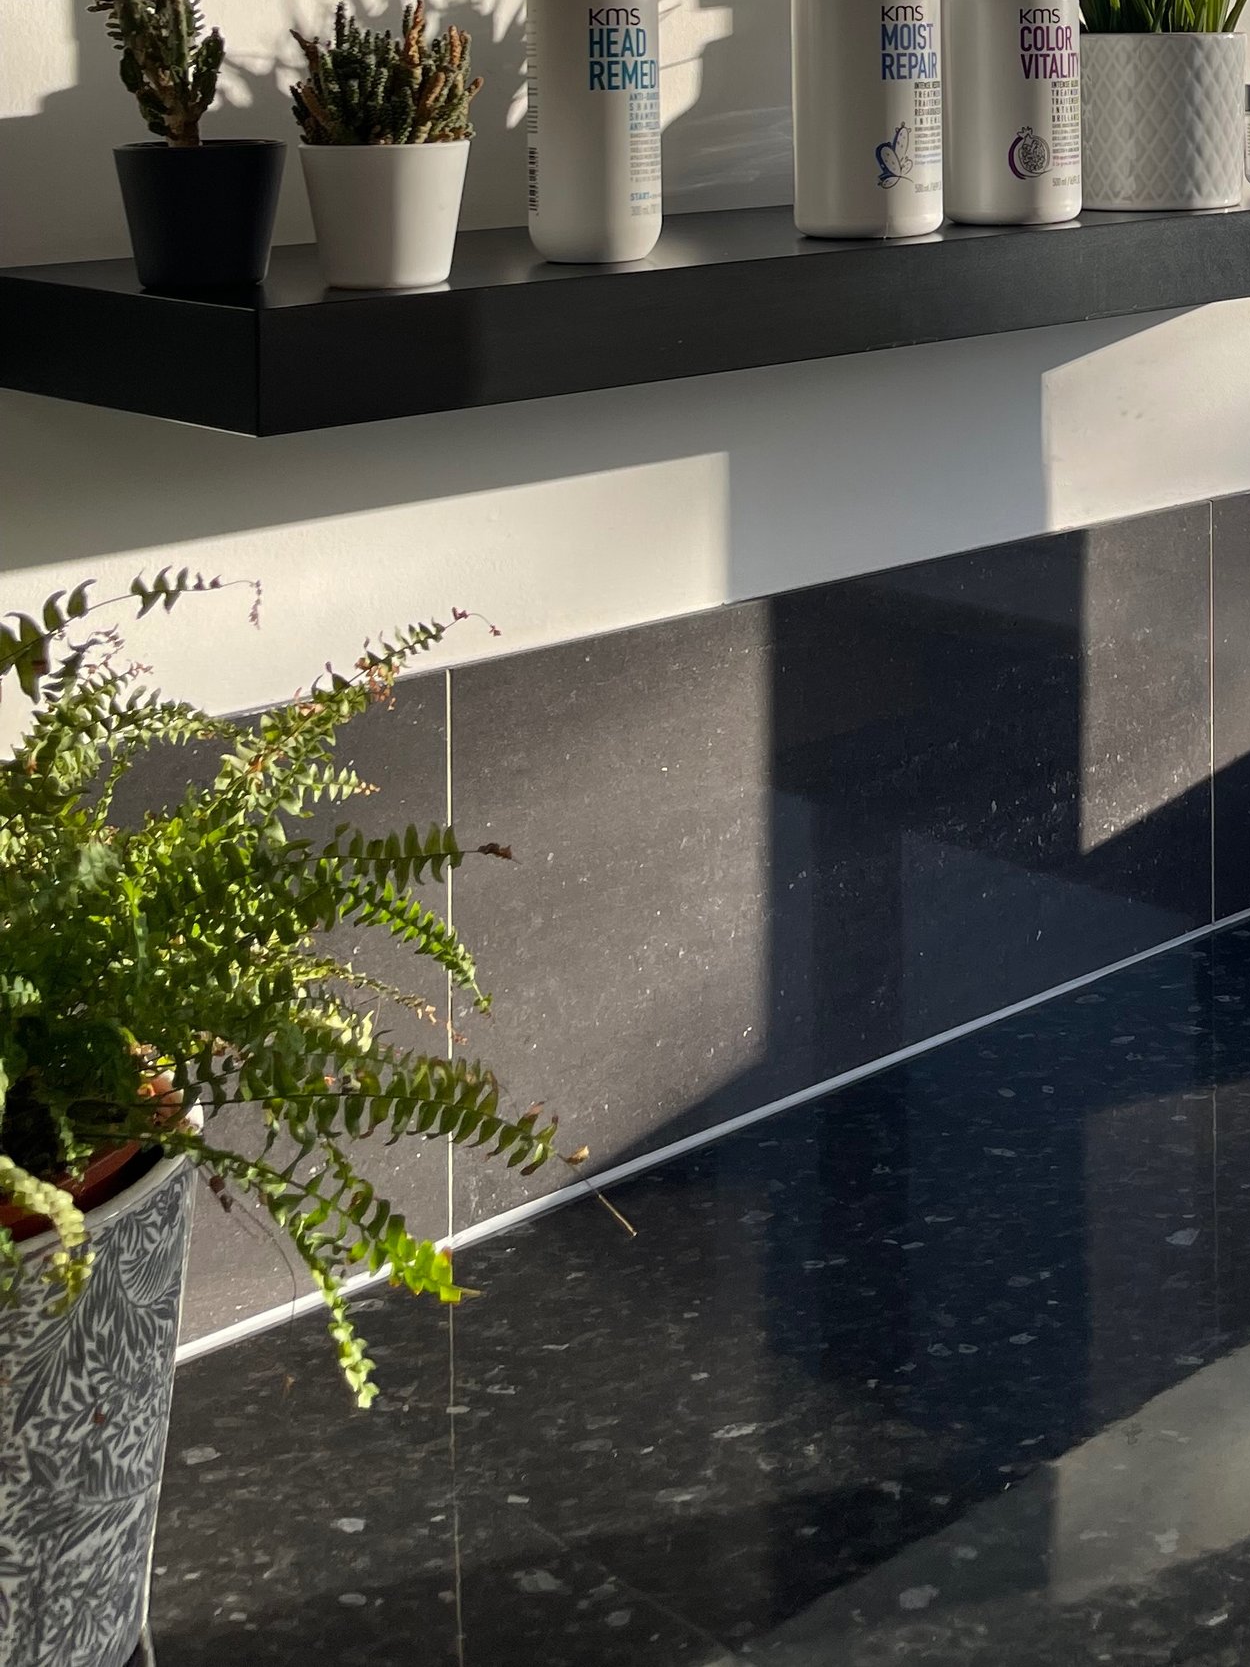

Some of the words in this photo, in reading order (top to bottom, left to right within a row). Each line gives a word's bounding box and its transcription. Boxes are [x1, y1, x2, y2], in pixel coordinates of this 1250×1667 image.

[589, 28, 647, 58] HEAD
[881, 23, 933, 51] MOIST
[1020, 25, 1072, 52] COLOR
[589, 60, 659, 91] REMED
[881, 52, 938, 80] REPAIR
[1020, 53, 1079, 79] VITALITY
